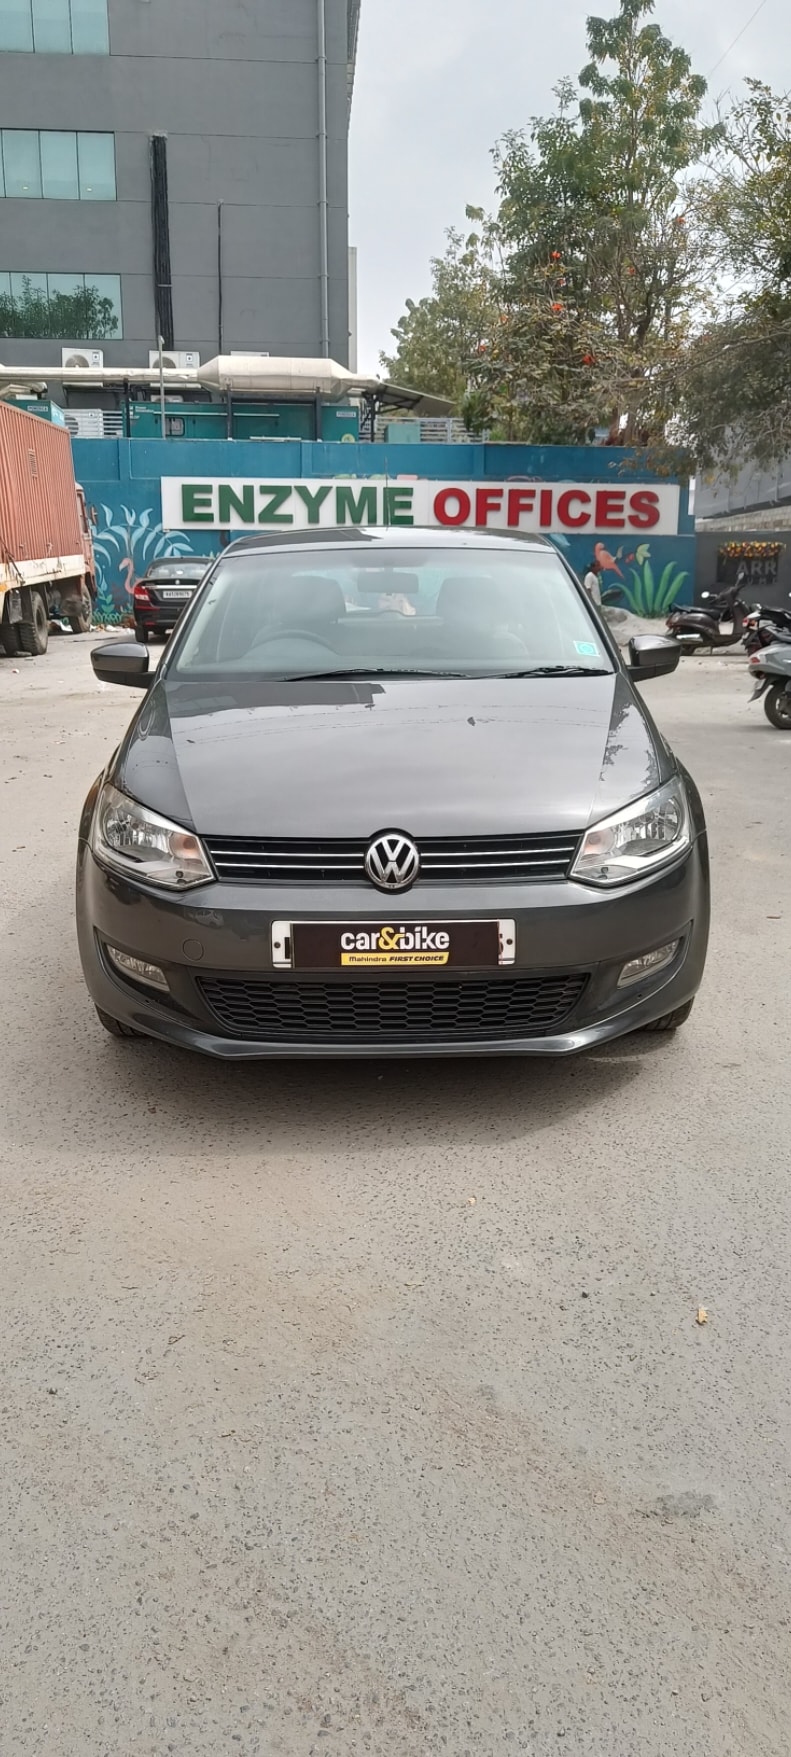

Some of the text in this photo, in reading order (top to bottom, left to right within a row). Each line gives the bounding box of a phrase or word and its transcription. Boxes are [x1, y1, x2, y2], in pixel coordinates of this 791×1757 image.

[182, 484, 660, 528] ENZYME OFFICES
[341, 926, 450, 950] car&bike
